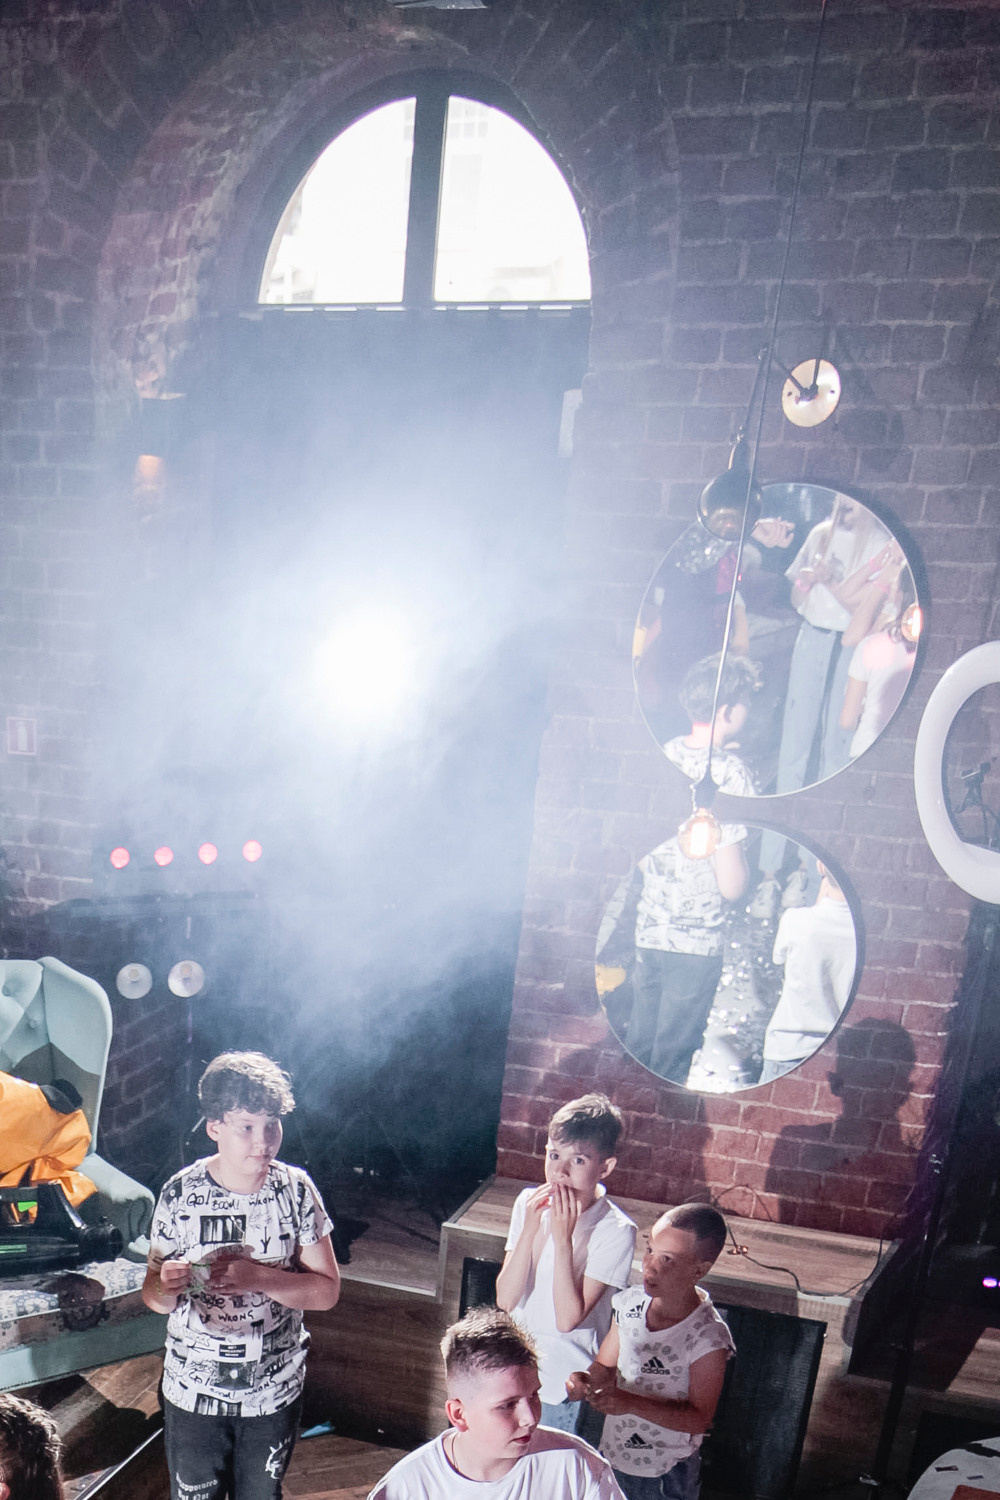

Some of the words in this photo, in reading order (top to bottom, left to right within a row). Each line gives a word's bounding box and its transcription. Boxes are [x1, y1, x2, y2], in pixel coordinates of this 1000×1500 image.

[249, 1196, 276, 1206] WRON
[218, 1310, 254, 1322] WRONG
[641, 1367, 670, 1375] adidas
